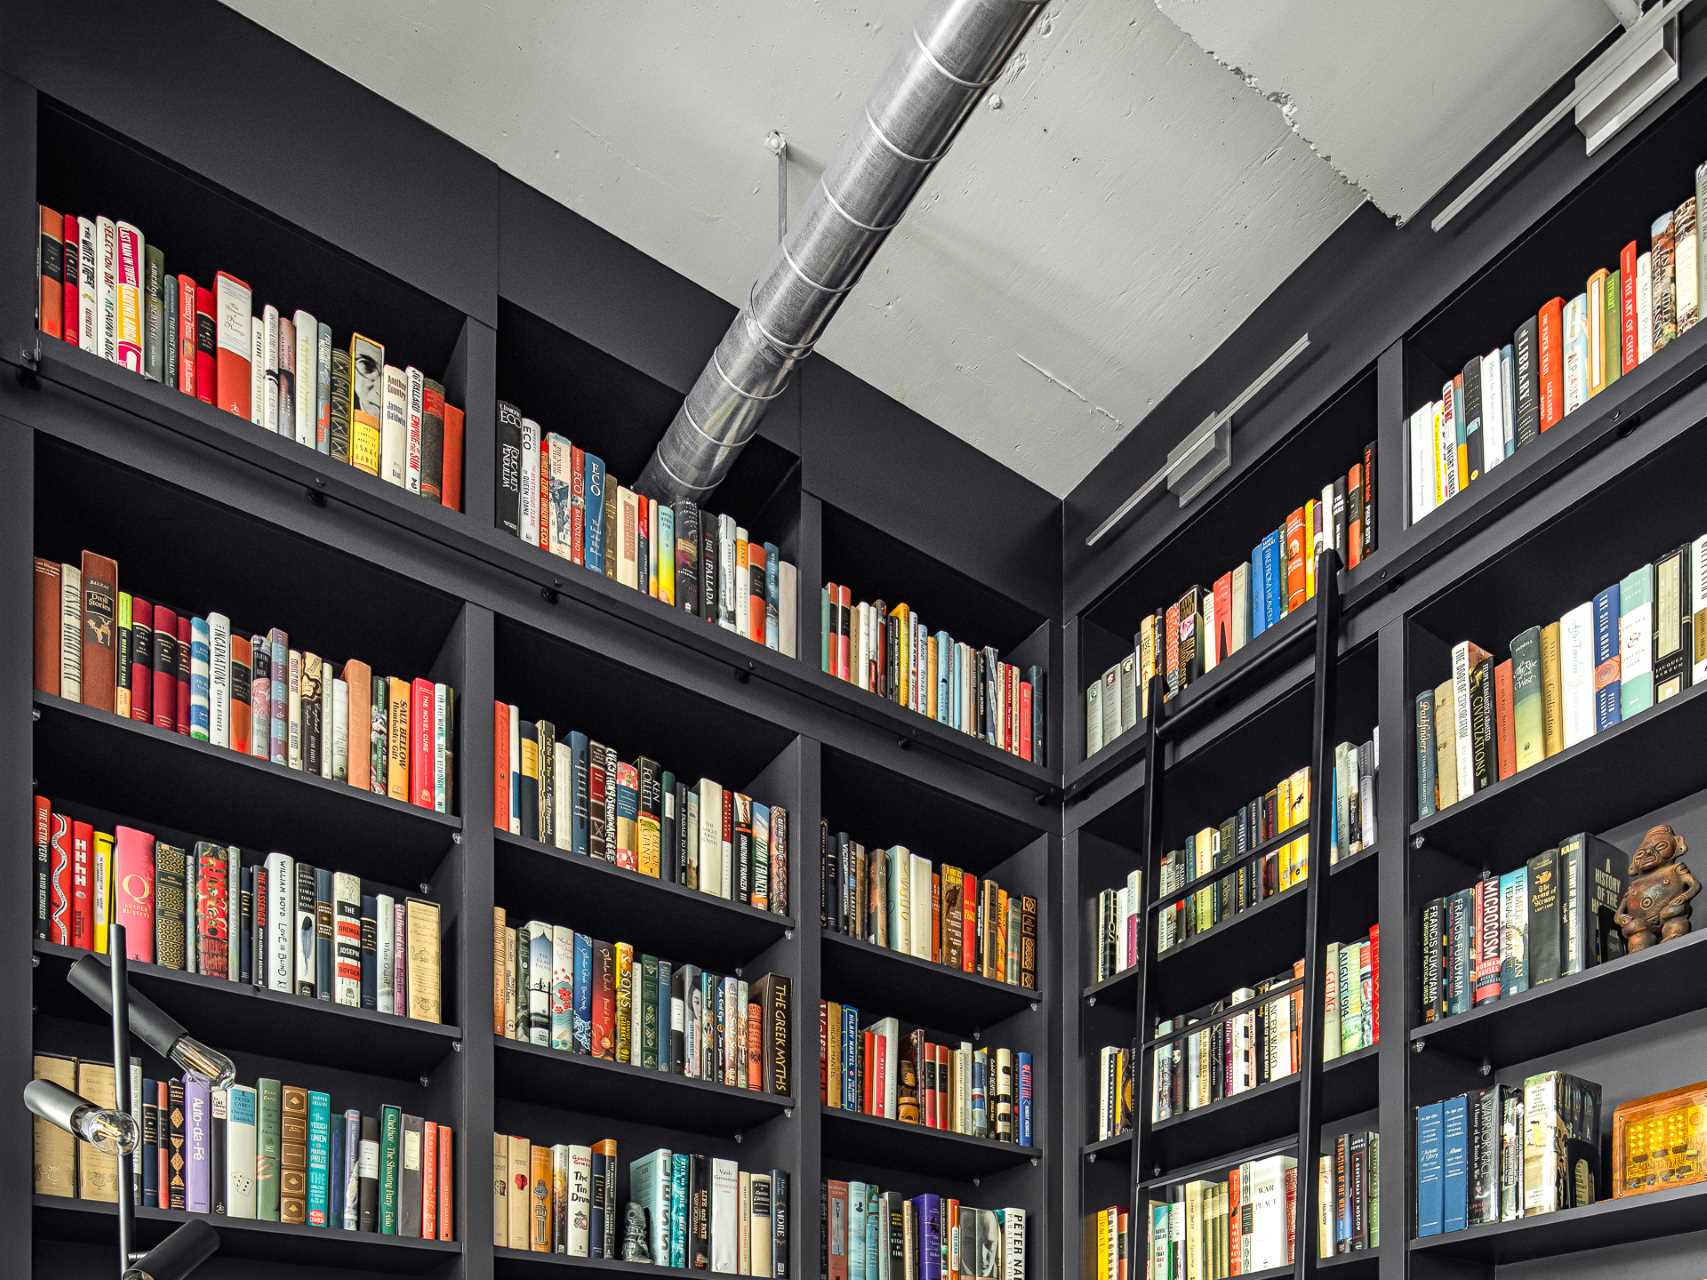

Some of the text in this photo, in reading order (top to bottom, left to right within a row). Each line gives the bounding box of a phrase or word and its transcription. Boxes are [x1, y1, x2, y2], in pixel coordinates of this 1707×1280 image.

[82, 239, 94, 262] WHITE
[119, 227, 131, 243] LAST
[122, 243, 133, 256] MAN
[104, 224, 114, 288] SELECTION DAY
[83, 264, 94, 289] TIGER
[124, 263, 137, 286] TOWER
[1625, 275, 1633, 296] THE
[1625, 298, 1633, 318] ART
[1625, 320, 1633, 332] OF
[1519, 341, 1529, 401] LIBRARY
[412, 381, 420, 412] BALLARD
[523, 426, 531, 449] ECO
[502, 444, 511, 488] PENDULUM
[591, 463, 601, 496] ECO
[1599, 594, 1609, 659] THE SILK ROADS
[214, 629, 226, 687] INCARNATIONS
[1186, 637, 1195, 662] ATLAS
[1456, 648, 1468, 740] THE BOOK OF EXPLORATION
[1546, 683, 1554, 736] Civilization
[399, 700, 408, 769] SAUL BELLOW
[1417, 701, 1431, 752] Pathfinders
[1472, 695, 1486, 777] CIVILIZATIONS
[643, 767, 651, 808] FOLLETT
[652, 780, 660, 801] KEN
[40, 808, 48, 820] THE
[39, 822, 48, 862] BETRAYERS
[279, 860, 287, 893] WILLIAM
[755, 864, 767, 898] FRANZEN
[1595, 868, 1621, 894] HISTORY
[1606, 858, 1611, 873] A
[344, 906, 354, 914] THE
[1597, 887, 1618, 908] OF THE
[1483, 880, 1499, 960] MICROCOSM
[340, 947, 359, 957] JOSEPH
[1423, 943, 1429, 954] OF
[1429, 905, 1438, 1003] FRANCIS FUKUYAMA
[1454, 898, 1464, 997] FRANCIS FUKUYAMA
[1339, 951, 1350, 1018] AUGUST 1914
[776, 985, 786, 1090] THE GREEK MYTHS
[192, 1098, 205, 1161] Auto-da-Fé
[1481, 1100, 1491, 1178] WARRIOR RACE
[384, 1114, 396, 1227] Chekhov The Shooting Party Folio
[1336, 1143, 1344, 1172] FRACTION
[574, 1171, 588, 1183] The
[575, 1184, 588, 1193] Tin
[1337, 1174, 1344, 1183] OF
[1355, 1195, 1360, 1203] IN
[1013, 1214, 1023, 1254] PÉTER
